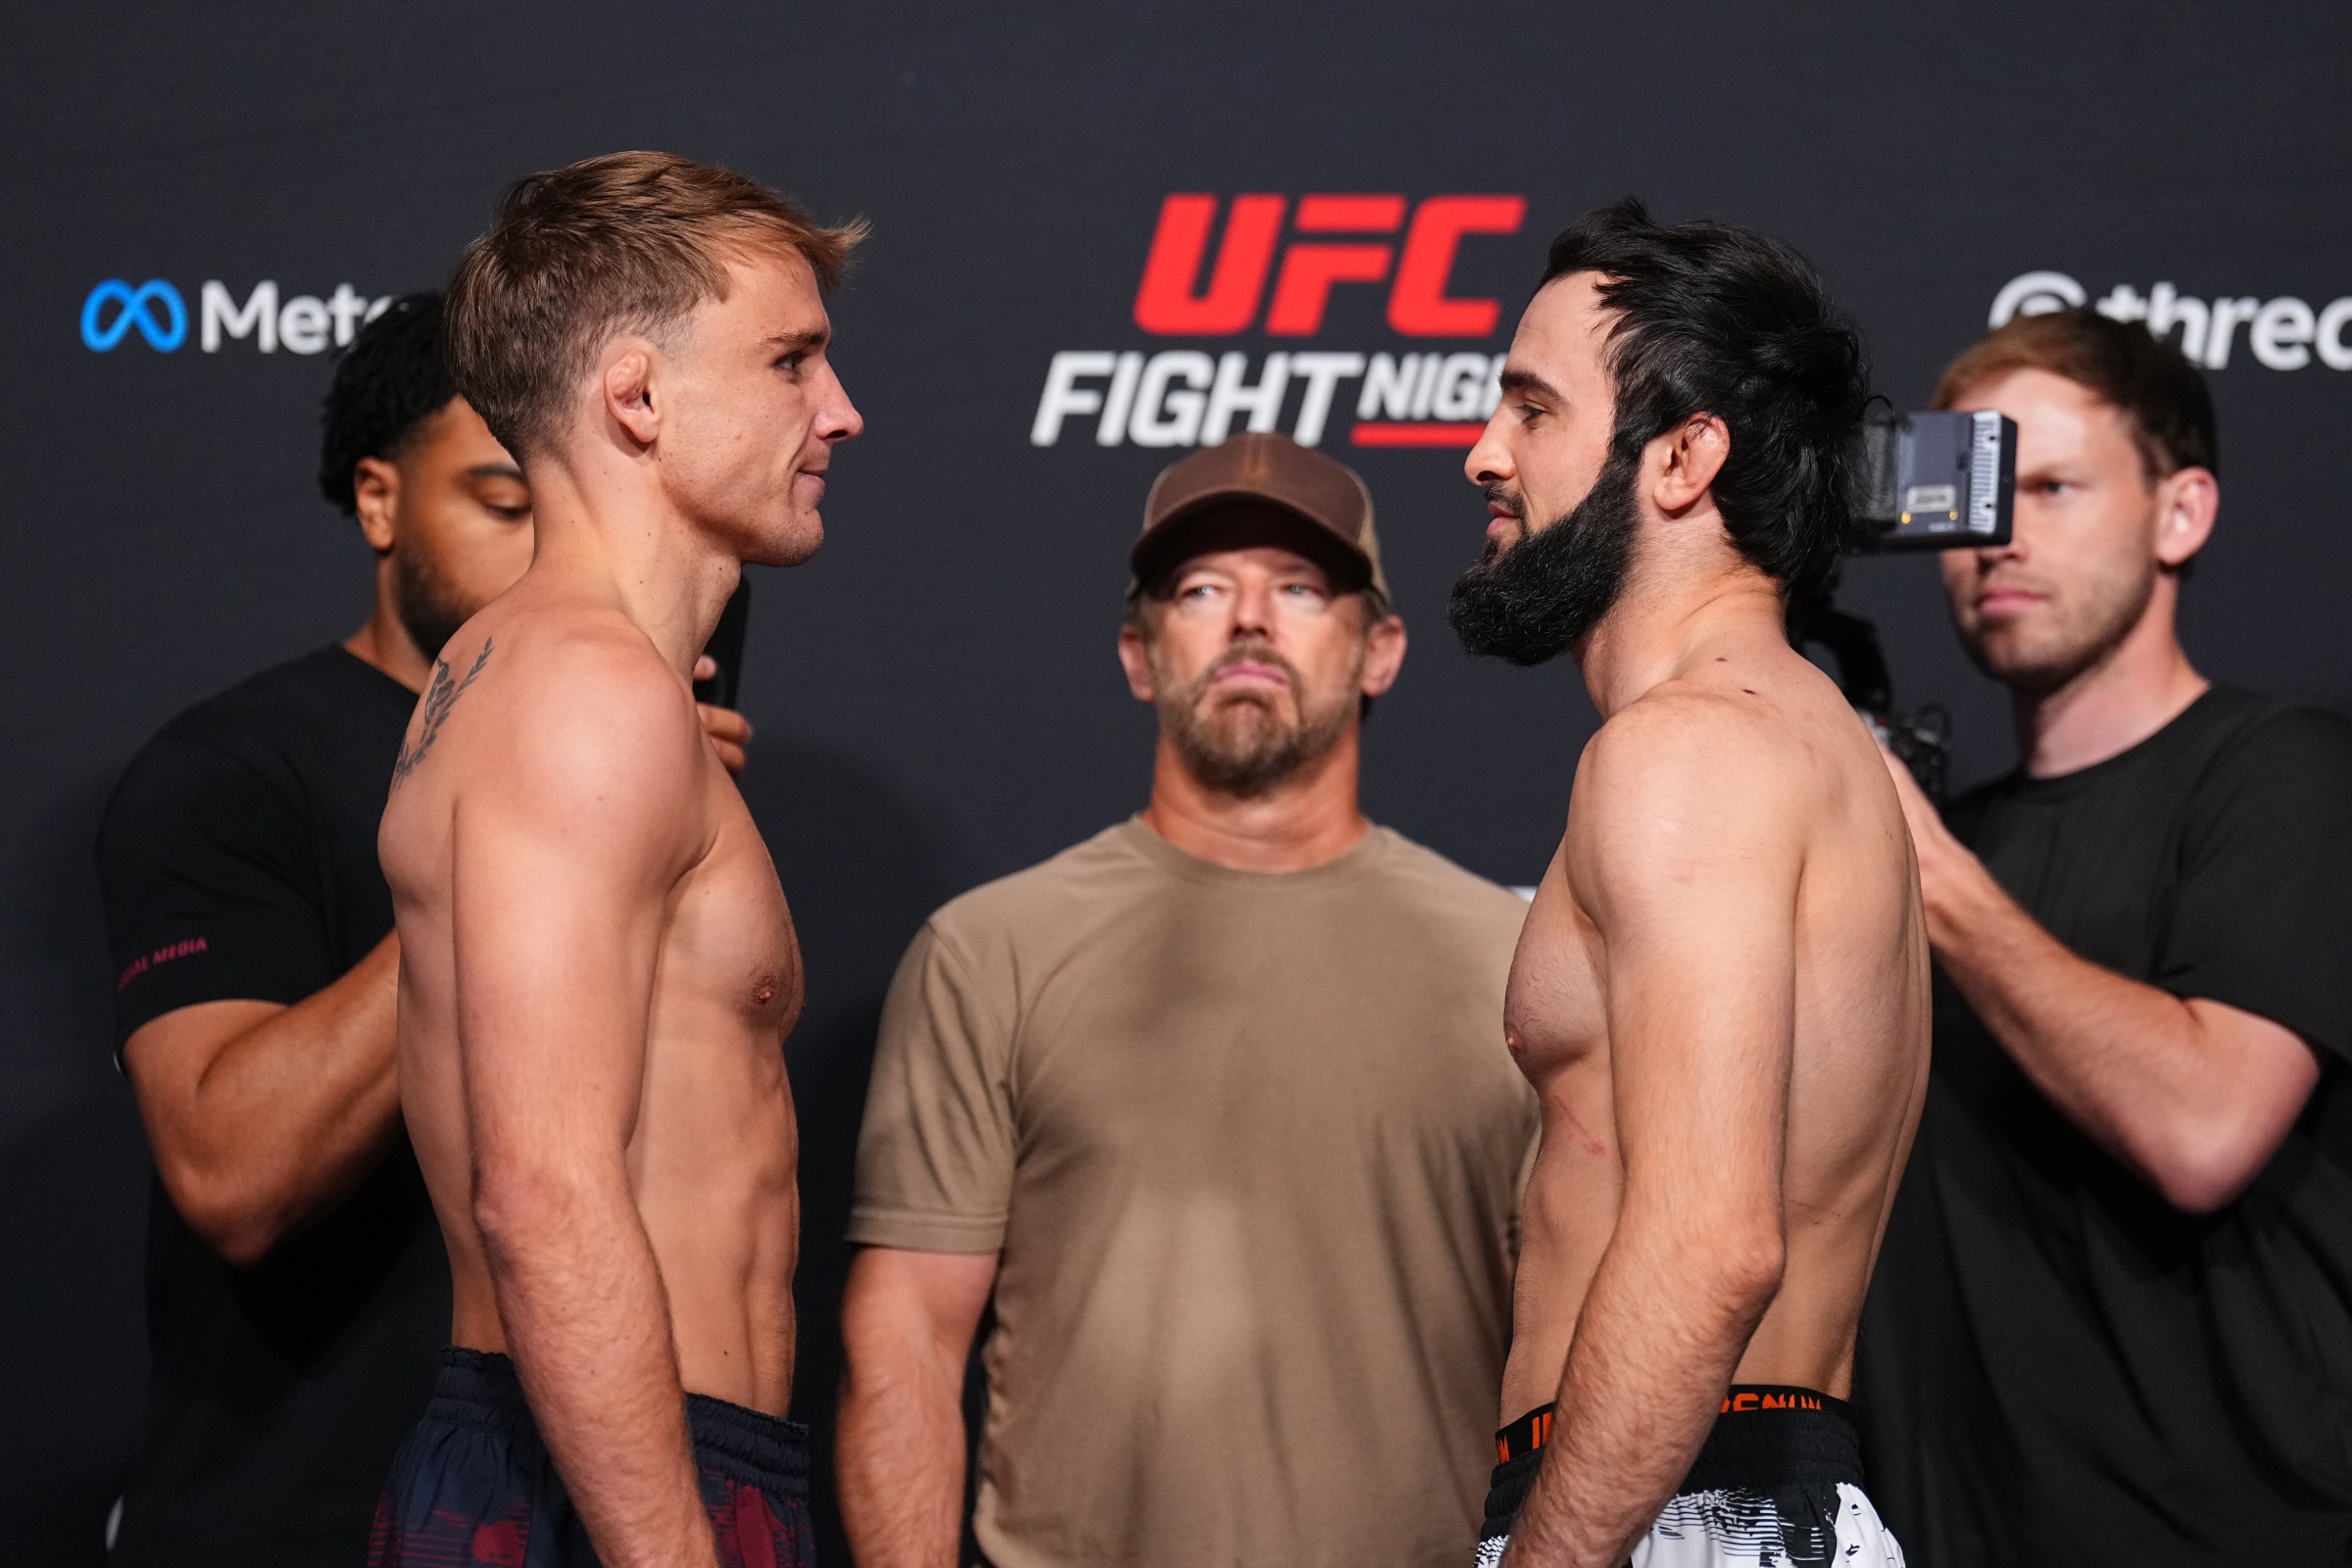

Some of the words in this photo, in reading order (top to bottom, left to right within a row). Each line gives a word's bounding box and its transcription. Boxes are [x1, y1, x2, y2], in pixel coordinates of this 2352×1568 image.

[1134, 193, 1527, 336] UFC
[202, 280, 393, 354] Met
[1031, 351, 1366, 448] FIGHT
[152, 936, 208, 964] MEDIA
